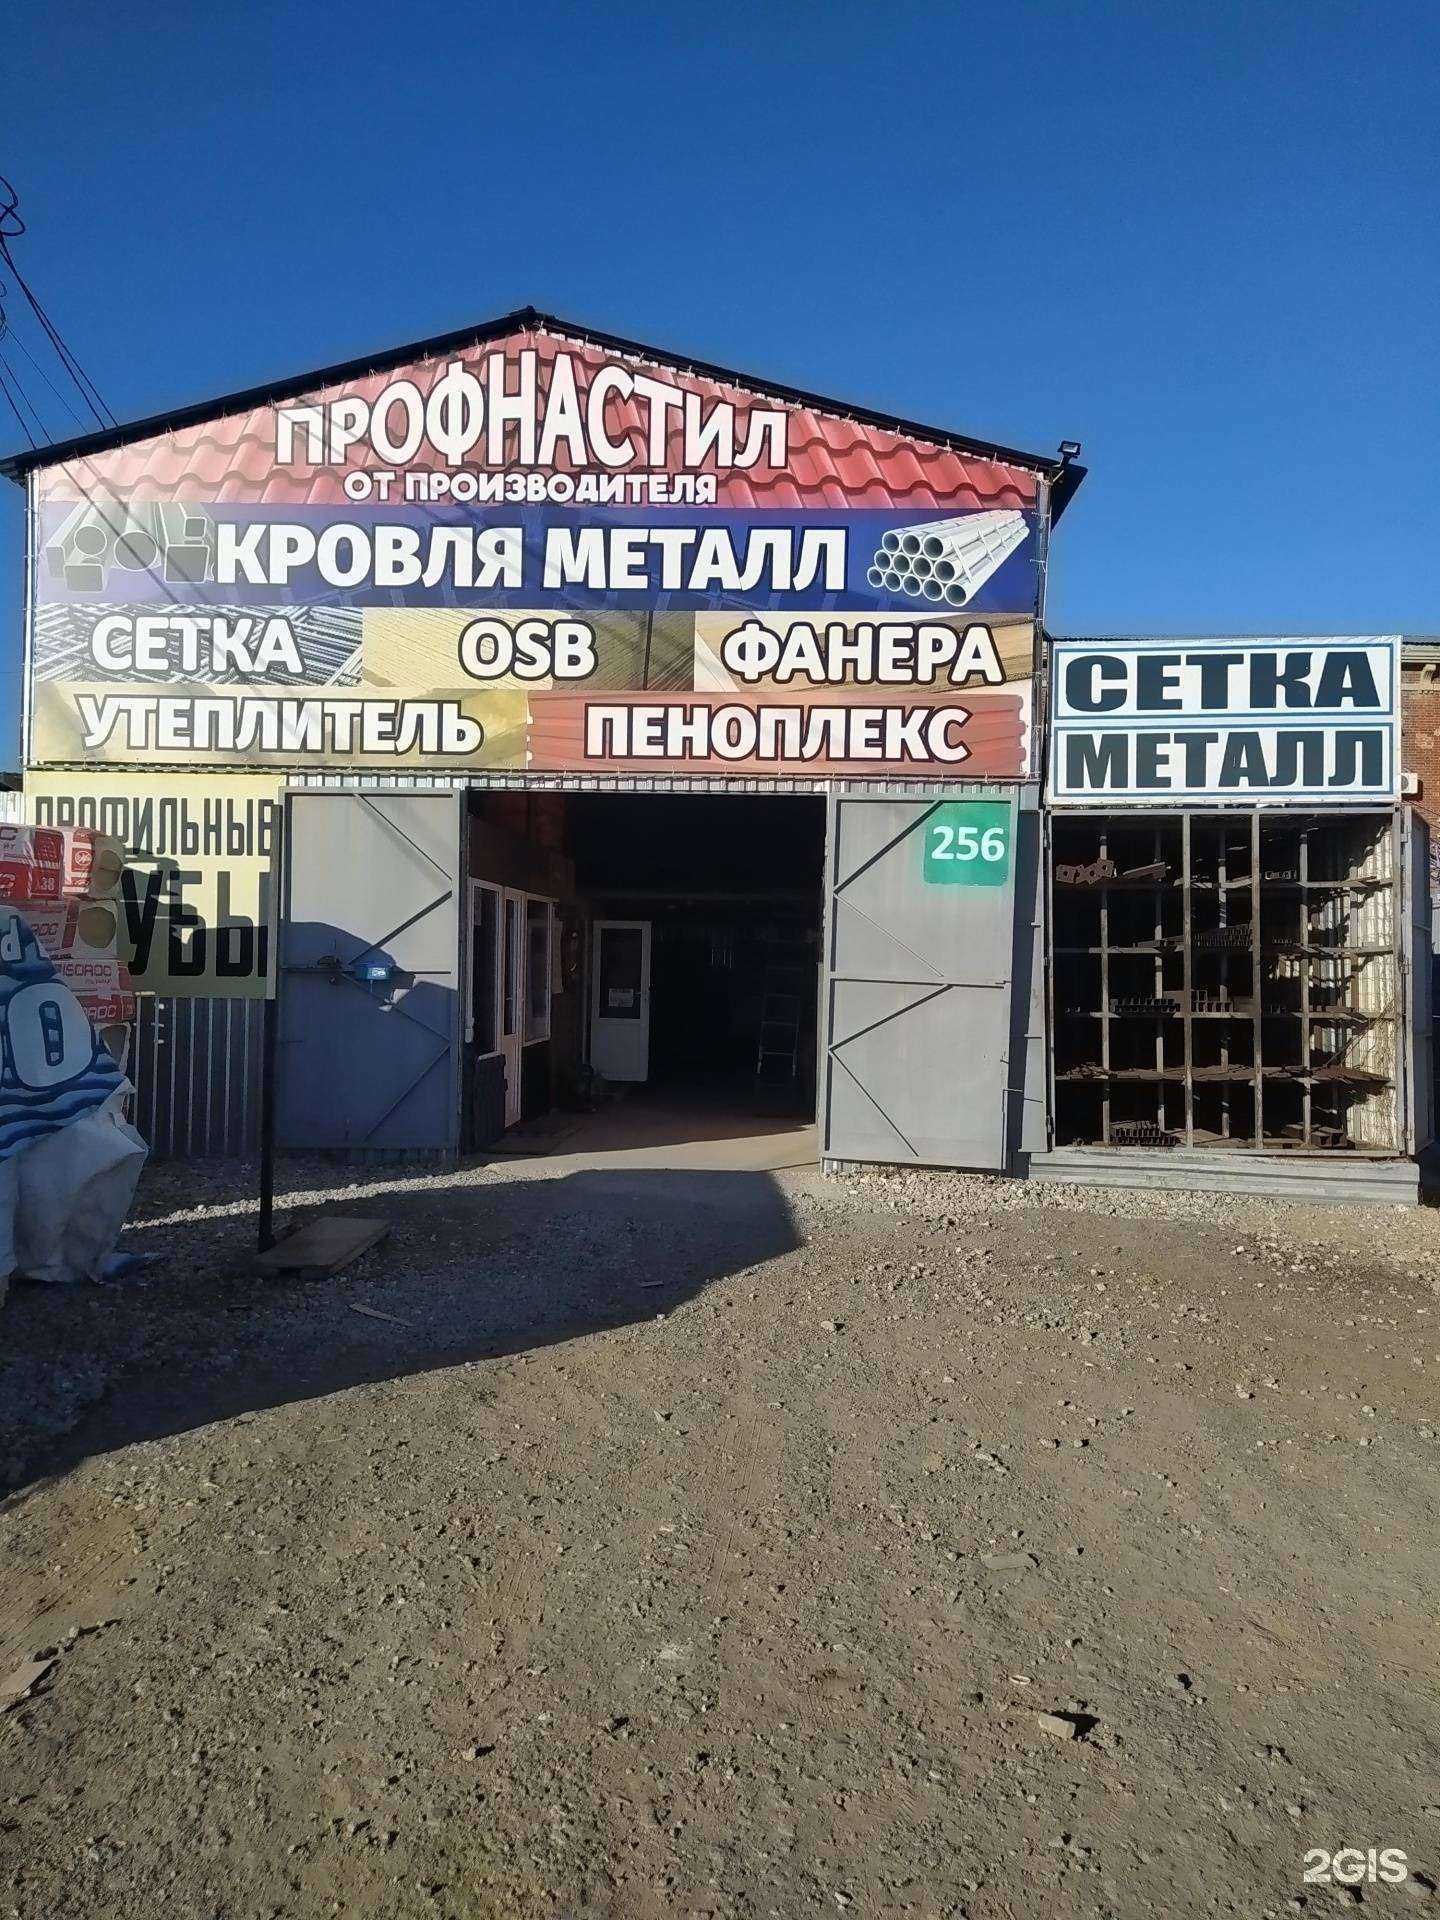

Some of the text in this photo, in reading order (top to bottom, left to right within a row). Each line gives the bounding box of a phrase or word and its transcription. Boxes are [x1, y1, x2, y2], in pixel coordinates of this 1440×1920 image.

[275, 348, 789, 470] ПРОФНАСТИЛ
[343, 471, 717, 504] ОТ ПРОИЗВОДИТЕЛЯ
[214, 522, 849, 592] КРОВЛЯ МЕТАЛЛ
[90, 613, 304, 674] СЕТКА
[458, 617, 596, 681] OSB
[721, 619, 1007, 685] ФАНЕРА
[1064, 651, 1381, 713] СЕТКА
[74, 693, 484, 755] УТЕПЛИТЕЛЬ
[584, 702, 973, 765] ПЕНОПЛЕКС
[1065, 730, 1384, 789] МЕТАЛЛ
[931, 825, 1005, 862] 256
[120, 869, 269, 977] УБЫ
